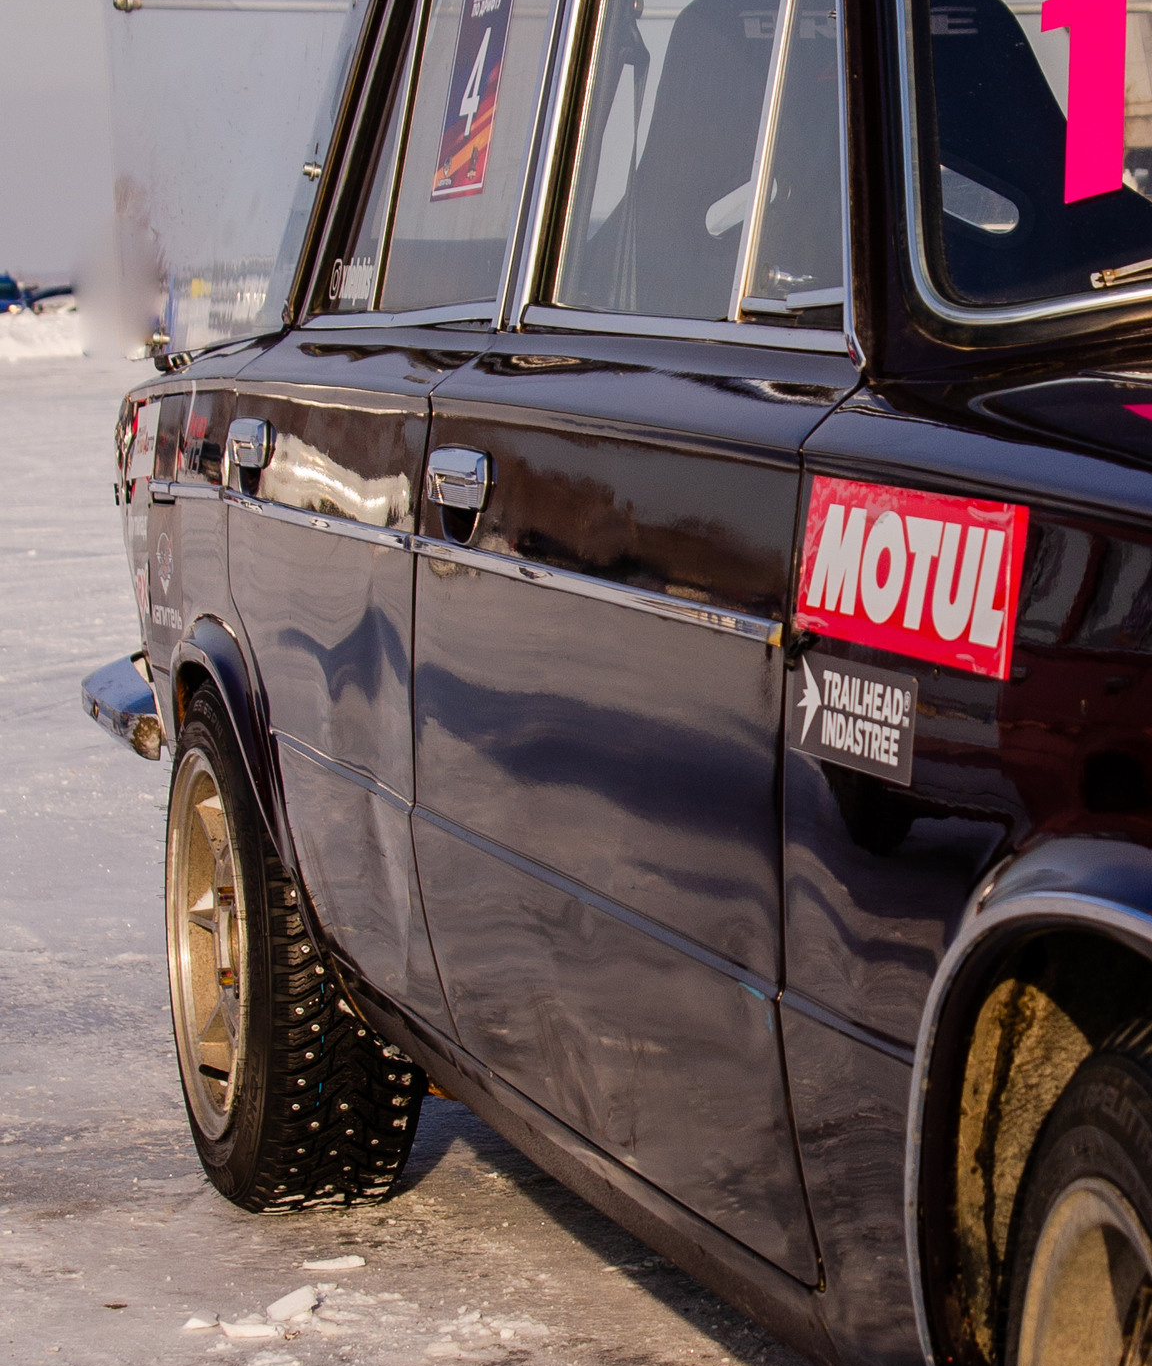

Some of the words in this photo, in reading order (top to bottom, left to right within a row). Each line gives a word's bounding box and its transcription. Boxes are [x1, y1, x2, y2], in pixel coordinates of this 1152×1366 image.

[459, 26, 491, 137] 4
[806, 503, 1006, 649] MOTUL
[821, 709, 899, 767] INDASTREE
